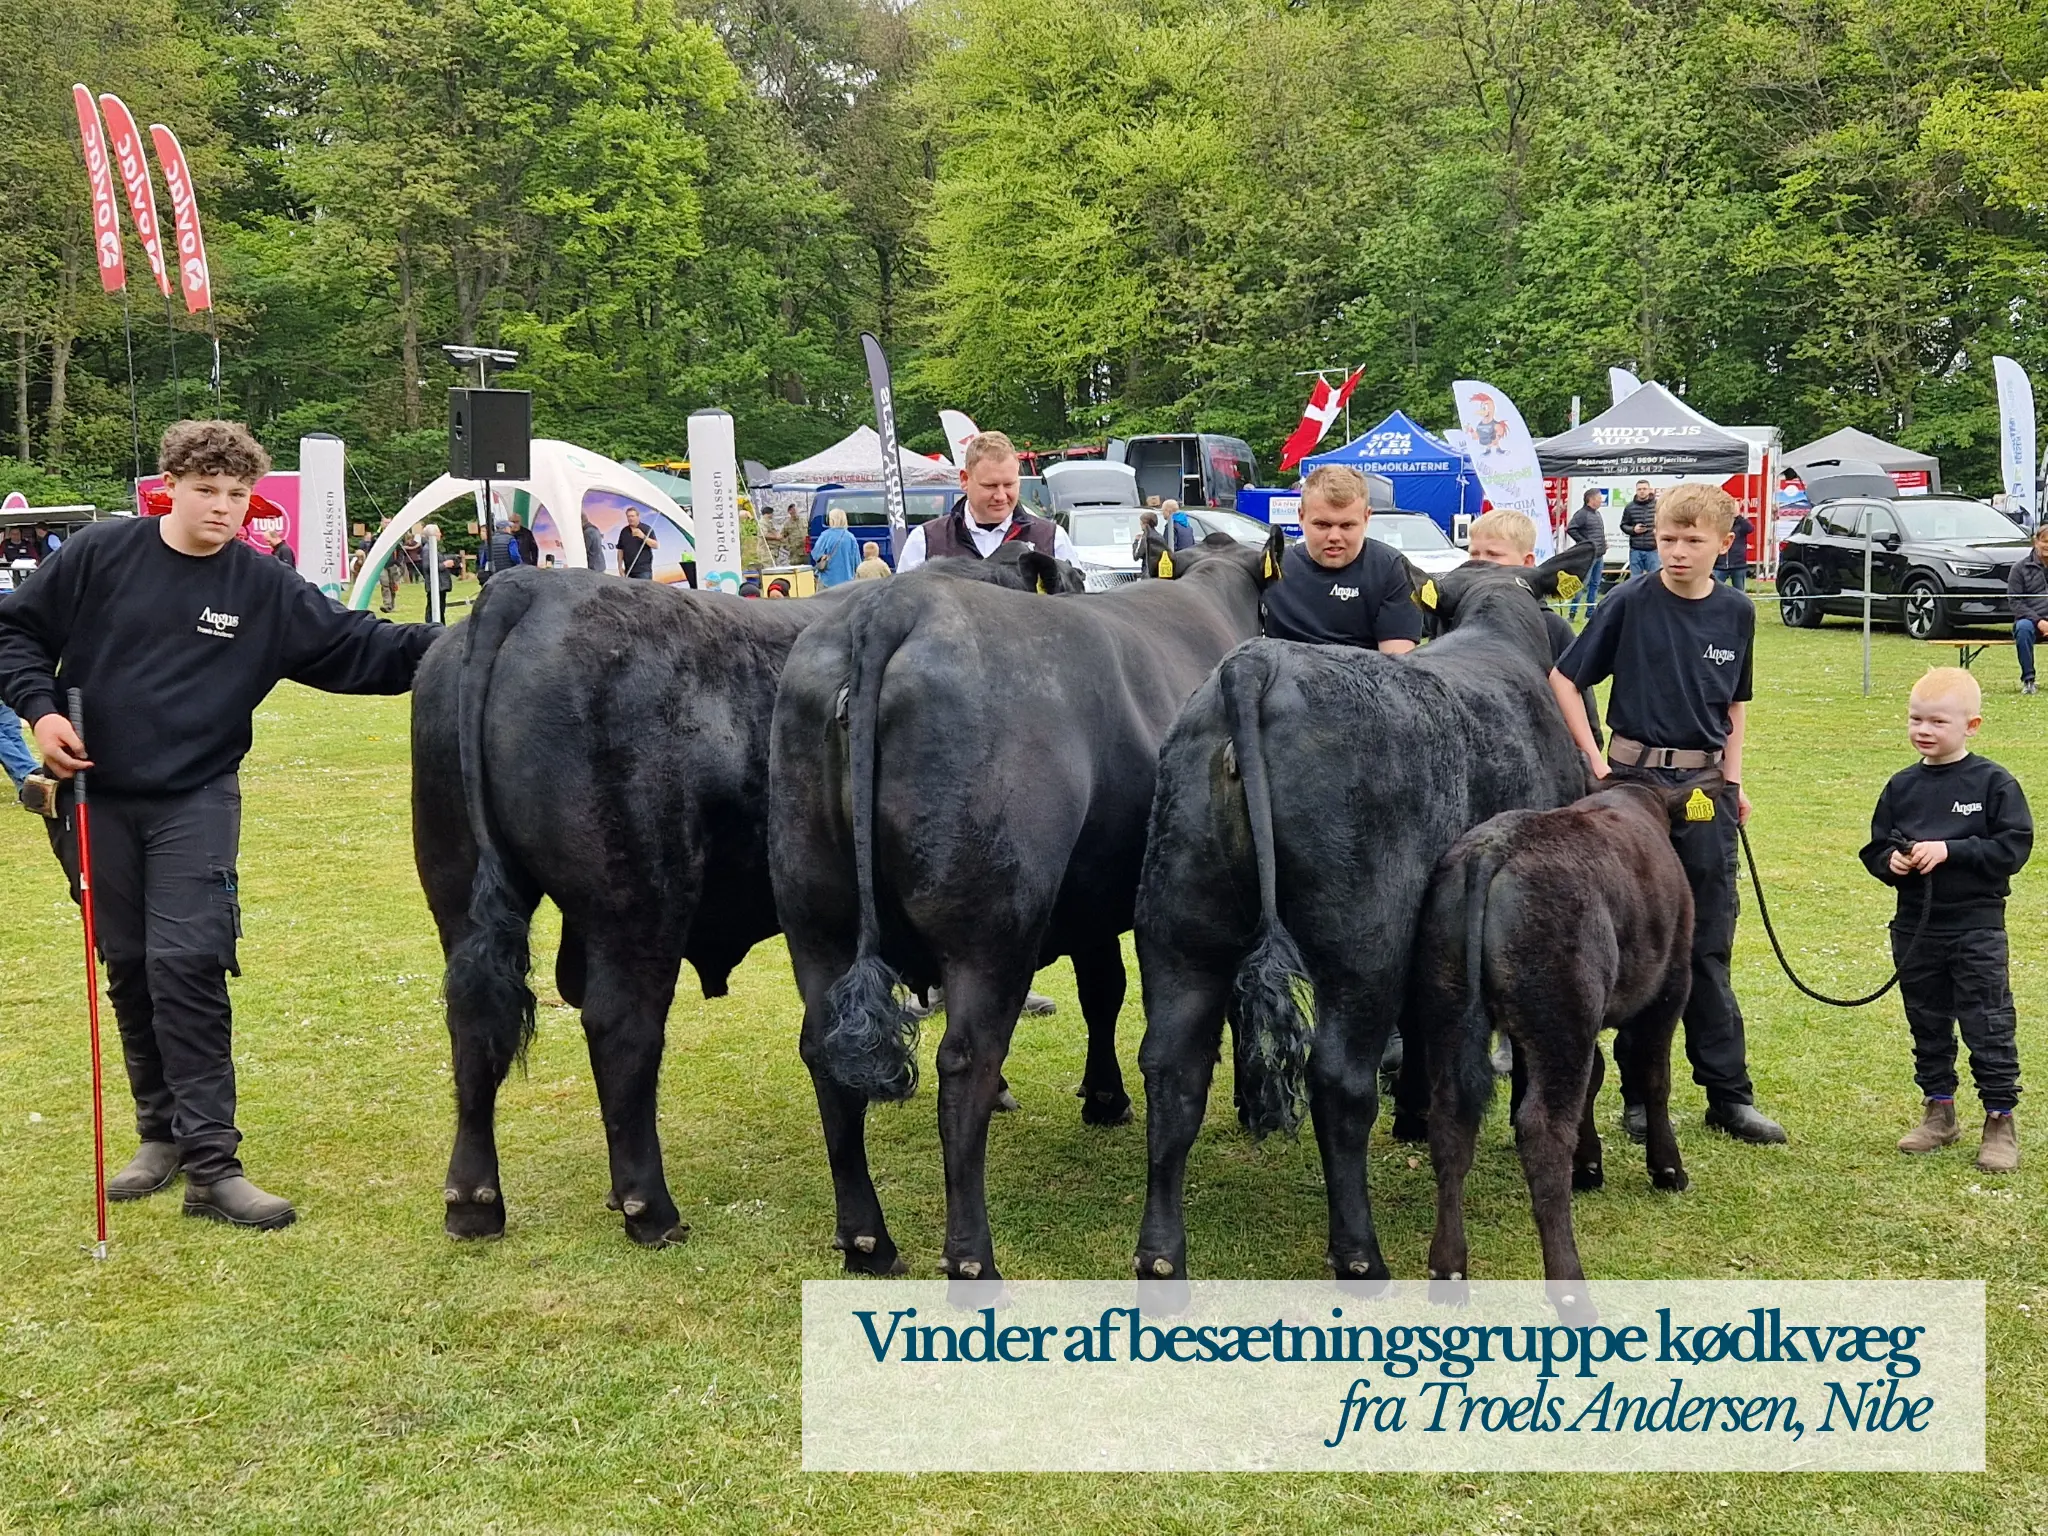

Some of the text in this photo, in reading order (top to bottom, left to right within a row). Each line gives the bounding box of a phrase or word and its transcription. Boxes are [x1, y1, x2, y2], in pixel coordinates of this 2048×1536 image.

[1371, 432, 1412, 441] SOM
[1591, 426, 1702, 438] MIDTVEJS
[1388, 440, 1412, 448] ER
[1592, 437, 1650, 446] AUTO
[1359, 448, 1413, 457] FLEST
[712, 471, 729, 563] Sparekassen
[320, 491, 335, 575] Sparekassen
[1329, 583, 1360, 601] Angus
[198, 606, 240, 630] Angus
[1703, 643, 1735, 666] Angus
[1951, 801, 1982, 816] Angus
